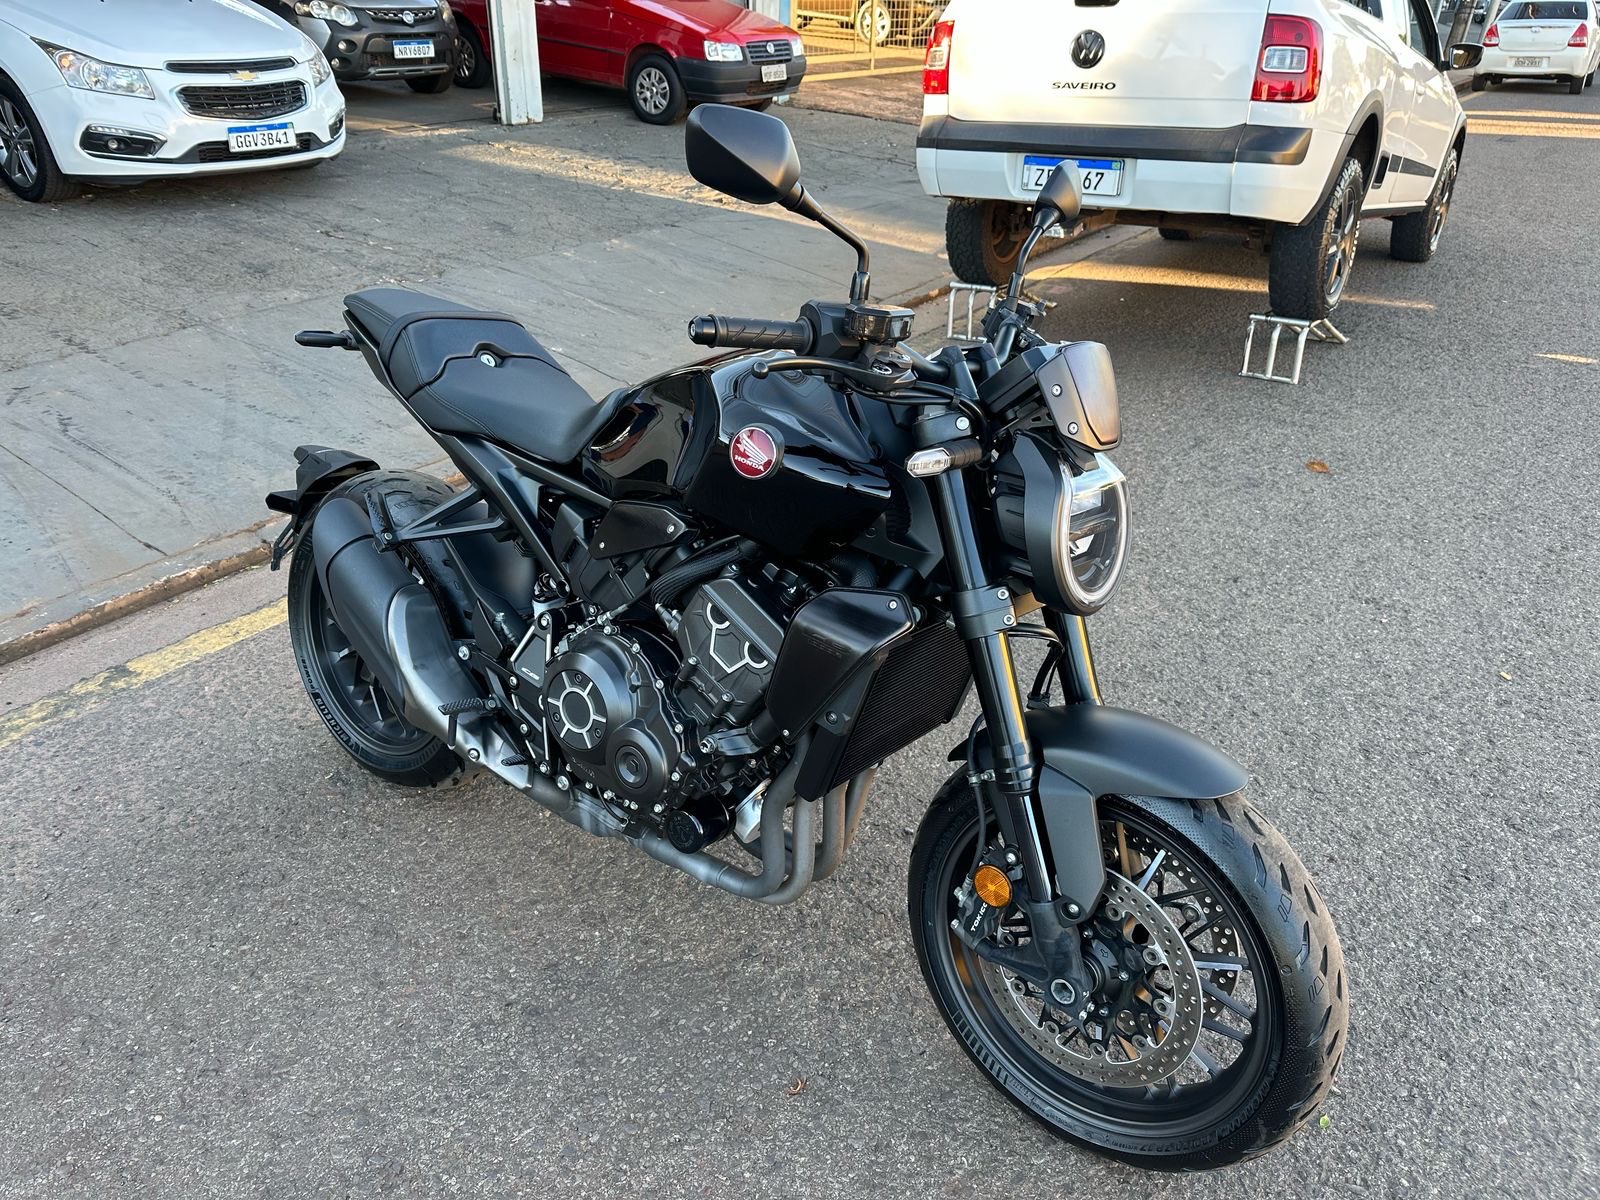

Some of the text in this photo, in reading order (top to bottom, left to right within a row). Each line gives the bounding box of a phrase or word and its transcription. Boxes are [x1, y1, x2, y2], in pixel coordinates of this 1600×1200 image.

[1052, 81, 1116, 91] SAVEIRO
[235, 131, 290, 148] GGV3B41
[734, 454, 765, 472] HONDA
[316, 698, 350, 743] MICHELIN
